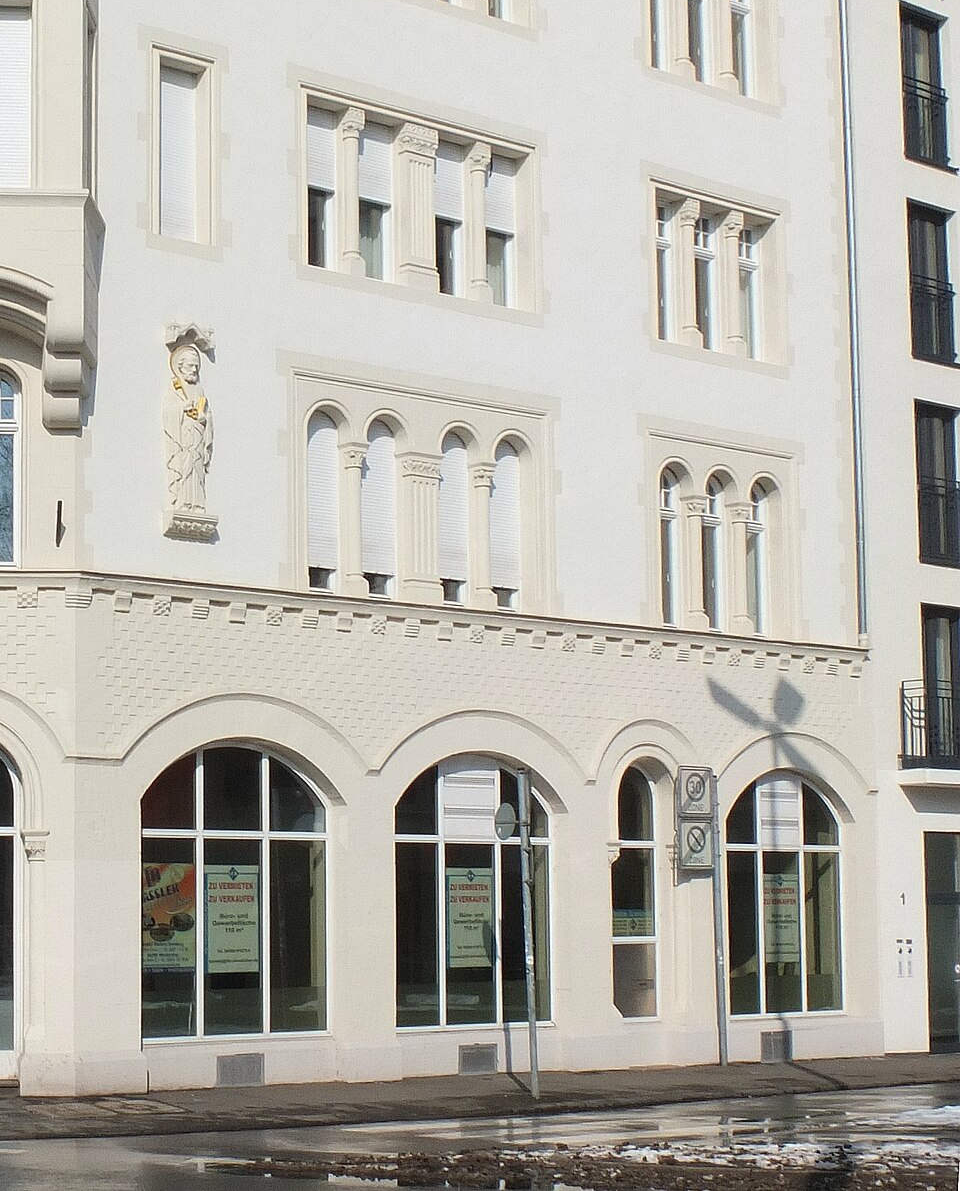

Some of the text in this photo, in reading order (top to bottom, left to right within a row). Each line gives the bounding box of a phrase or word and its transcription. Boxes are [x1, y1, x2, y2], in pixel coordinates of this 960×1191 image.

[689, 780, 701, 794] 30
[208, 895, 254, 903] ZU VERKAUFEN
[900, 892, 905, 905] 1
